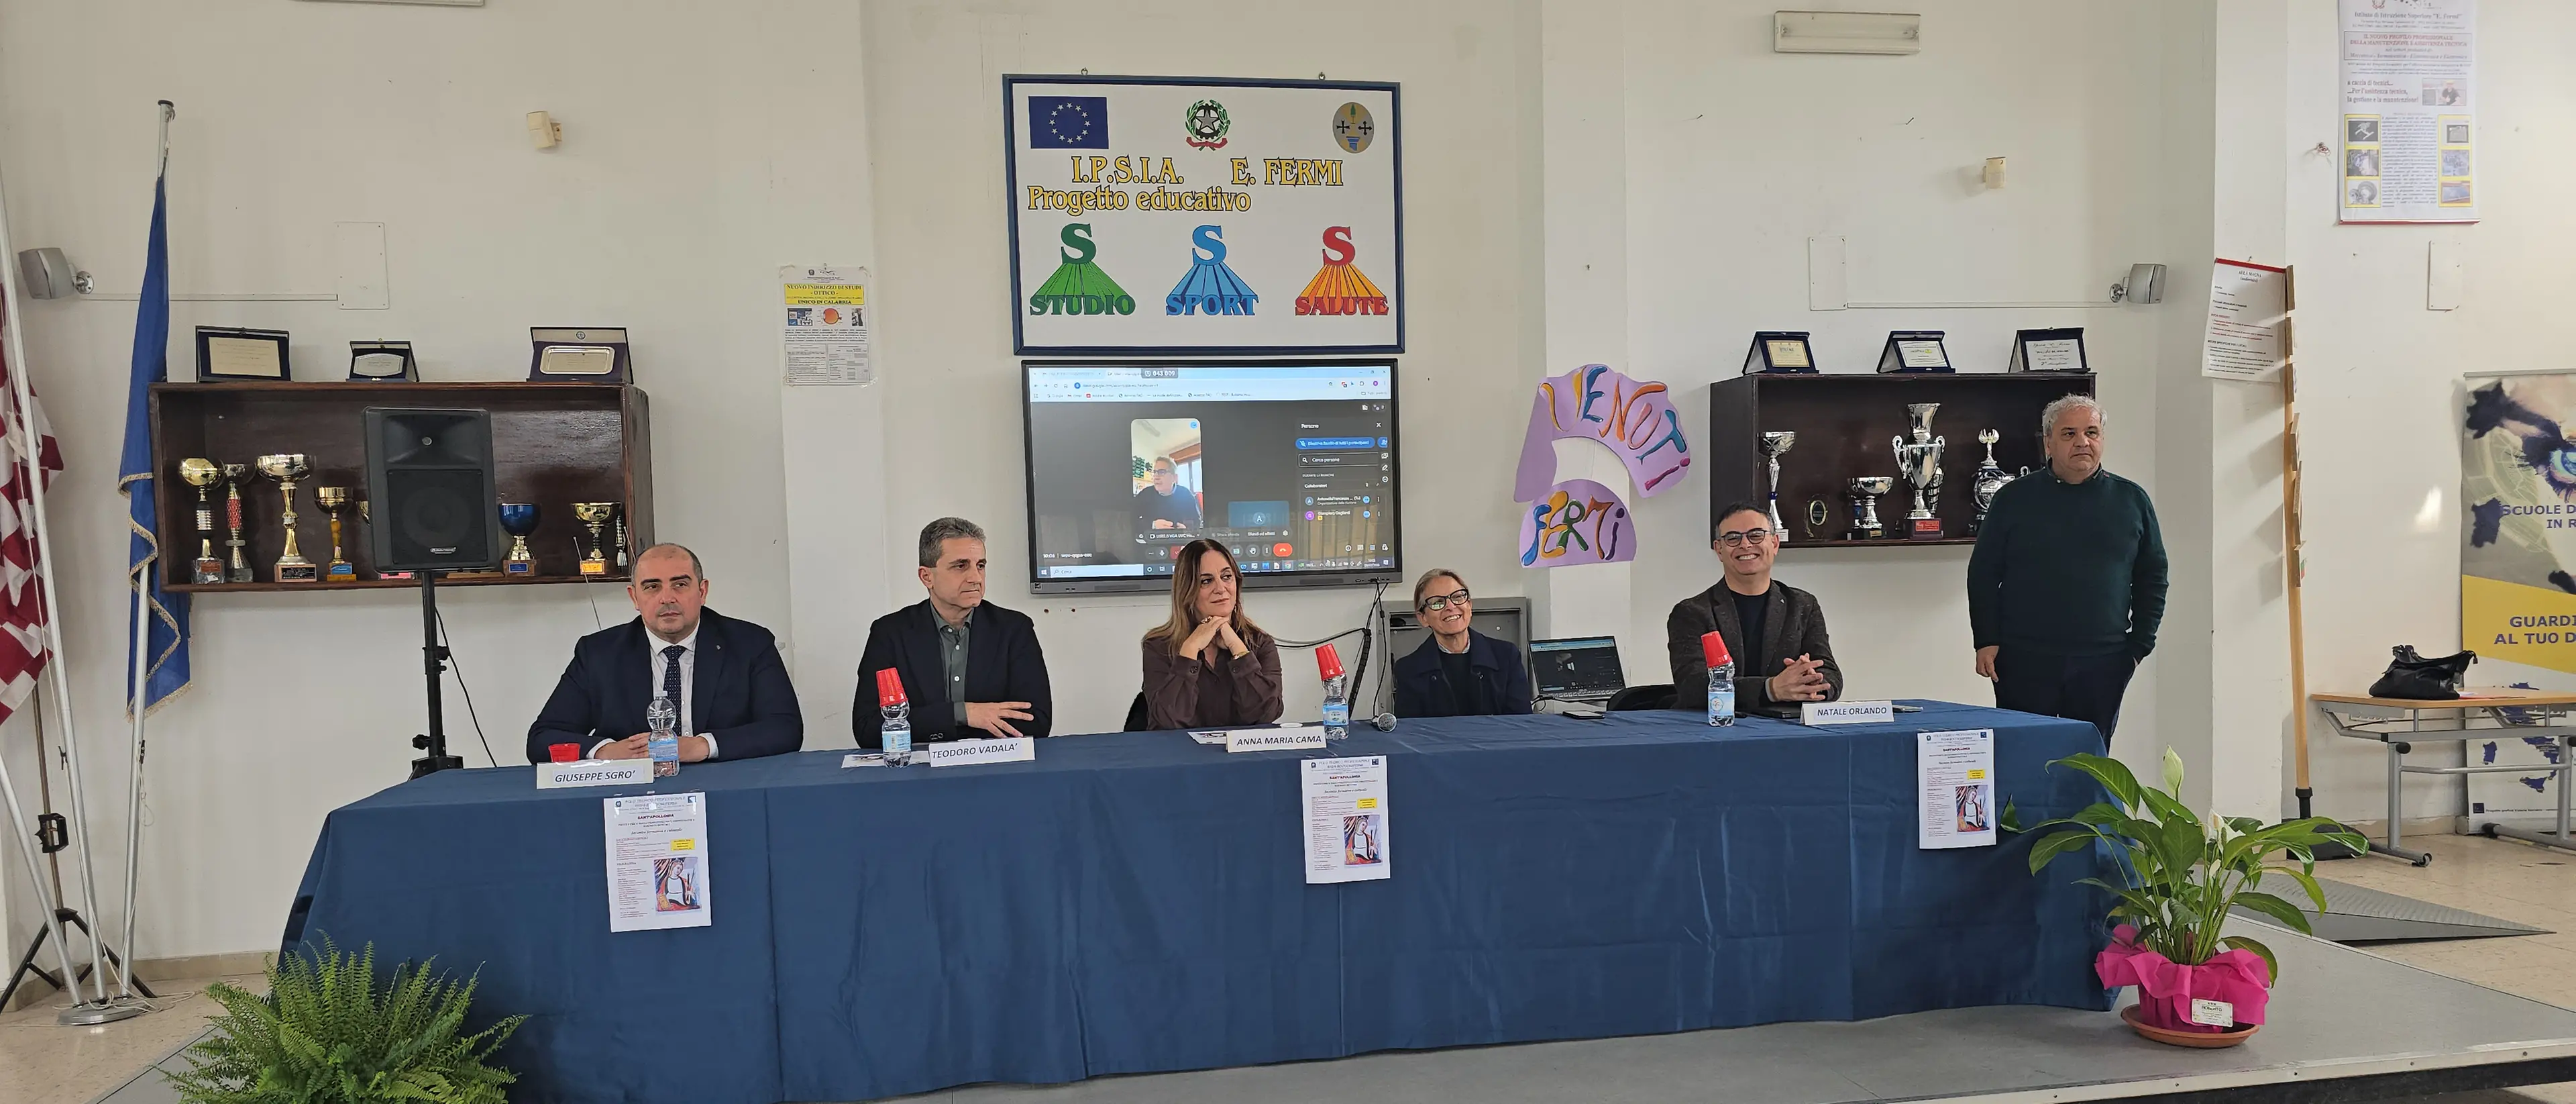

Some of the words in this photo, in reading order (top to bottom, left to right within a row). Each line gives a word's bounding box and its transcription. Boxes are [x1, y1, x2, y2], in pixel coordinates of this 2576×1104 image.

[1071, 156, 1185, 184] I.P.S.I.A.
[1231, 157, 1256, 185] E.
[1264, 157, 1343, 186] FERMI
[1028, 186, 1129, 216] Progetto
[1136, 187, 1251, 211] educativo
[1061, 223, 1096, 264] S
[1192, 225, 1227, 266] S
[1322, 226, 1356, 266] S
[1029, 294, 1136, 315] STUDIO
[1166, 294, 1259, 316] SPORT
[1295, 295, 1389, 316] SALUTE
[2501, 505, 2561, 515] SCUOLE
[1257, 514, 1263, 523] A
[2547, 519, 2562, 528] IN
[2493, 634, 2518, 644] AL
[2524, 632, 2559, 644] TUO
[1817, 708, 1847, 717] NATALE
[1849, 706, 1887, 715] ORLANDO
[1236, 737, 1263, 746] ANNA
[1265, 736, 1293, 745] MARIA
[1295, 735, 1322, 744] CAMA
[932, 747, 976, 758] TEODORO
[555, 772, 602, 783] GIUSEPPE
